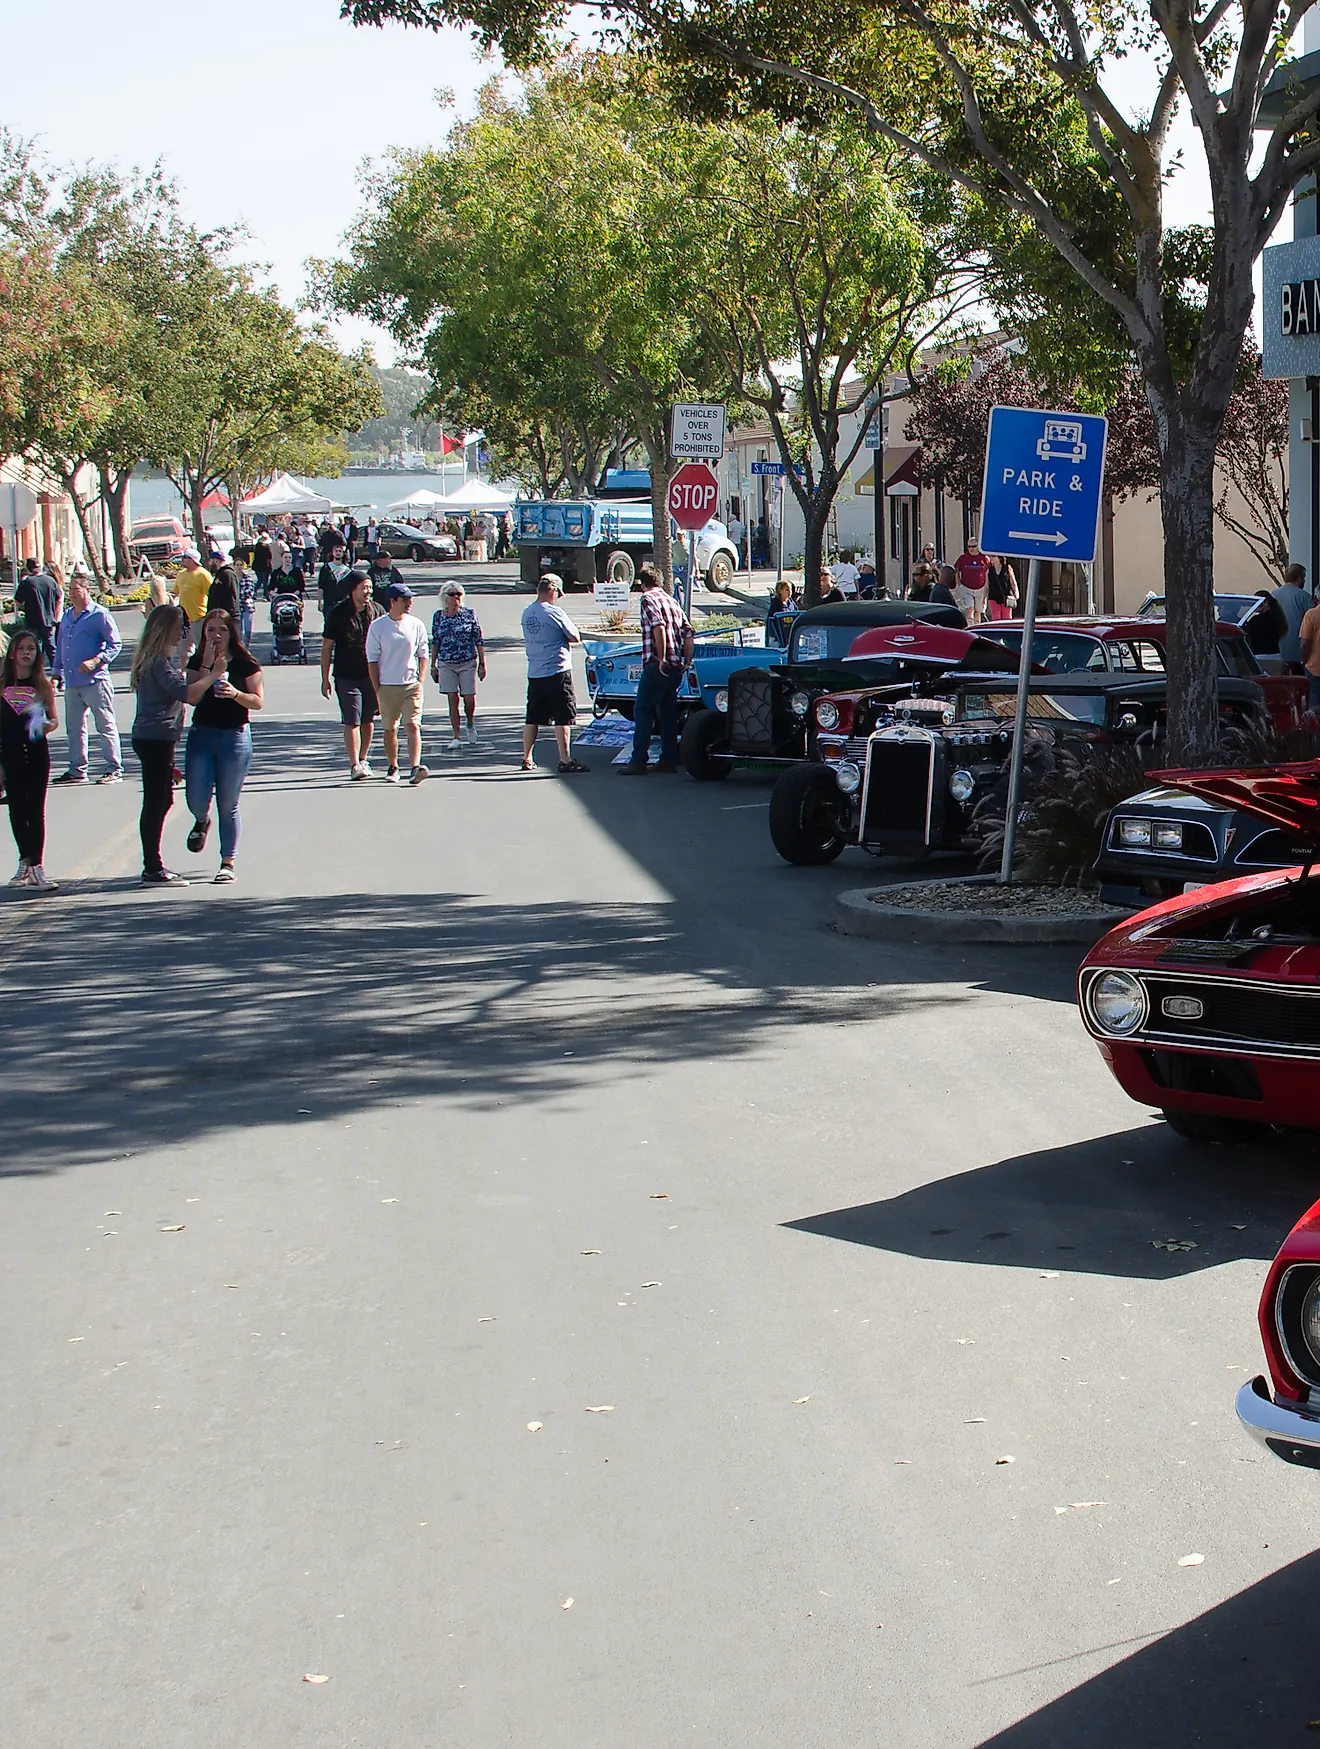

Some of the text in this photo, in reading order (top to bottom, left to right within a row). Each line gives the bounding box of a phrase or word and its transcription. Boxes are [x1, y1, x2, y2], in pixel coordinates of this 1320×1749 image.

[680, 409, 718, 419] VEHICLES
[687, 421, 709, 430] OVER
[682, 432, 713, 442] 5 TONS
[674, 443, 720, 453] PROHIBITED
[753, 463, 781, 474] S. Front
[1002, 468, 1083, 492] PARK &
[671, 483, 716, 511] STOP
[1019, 497, 1063, 518] RIDE
